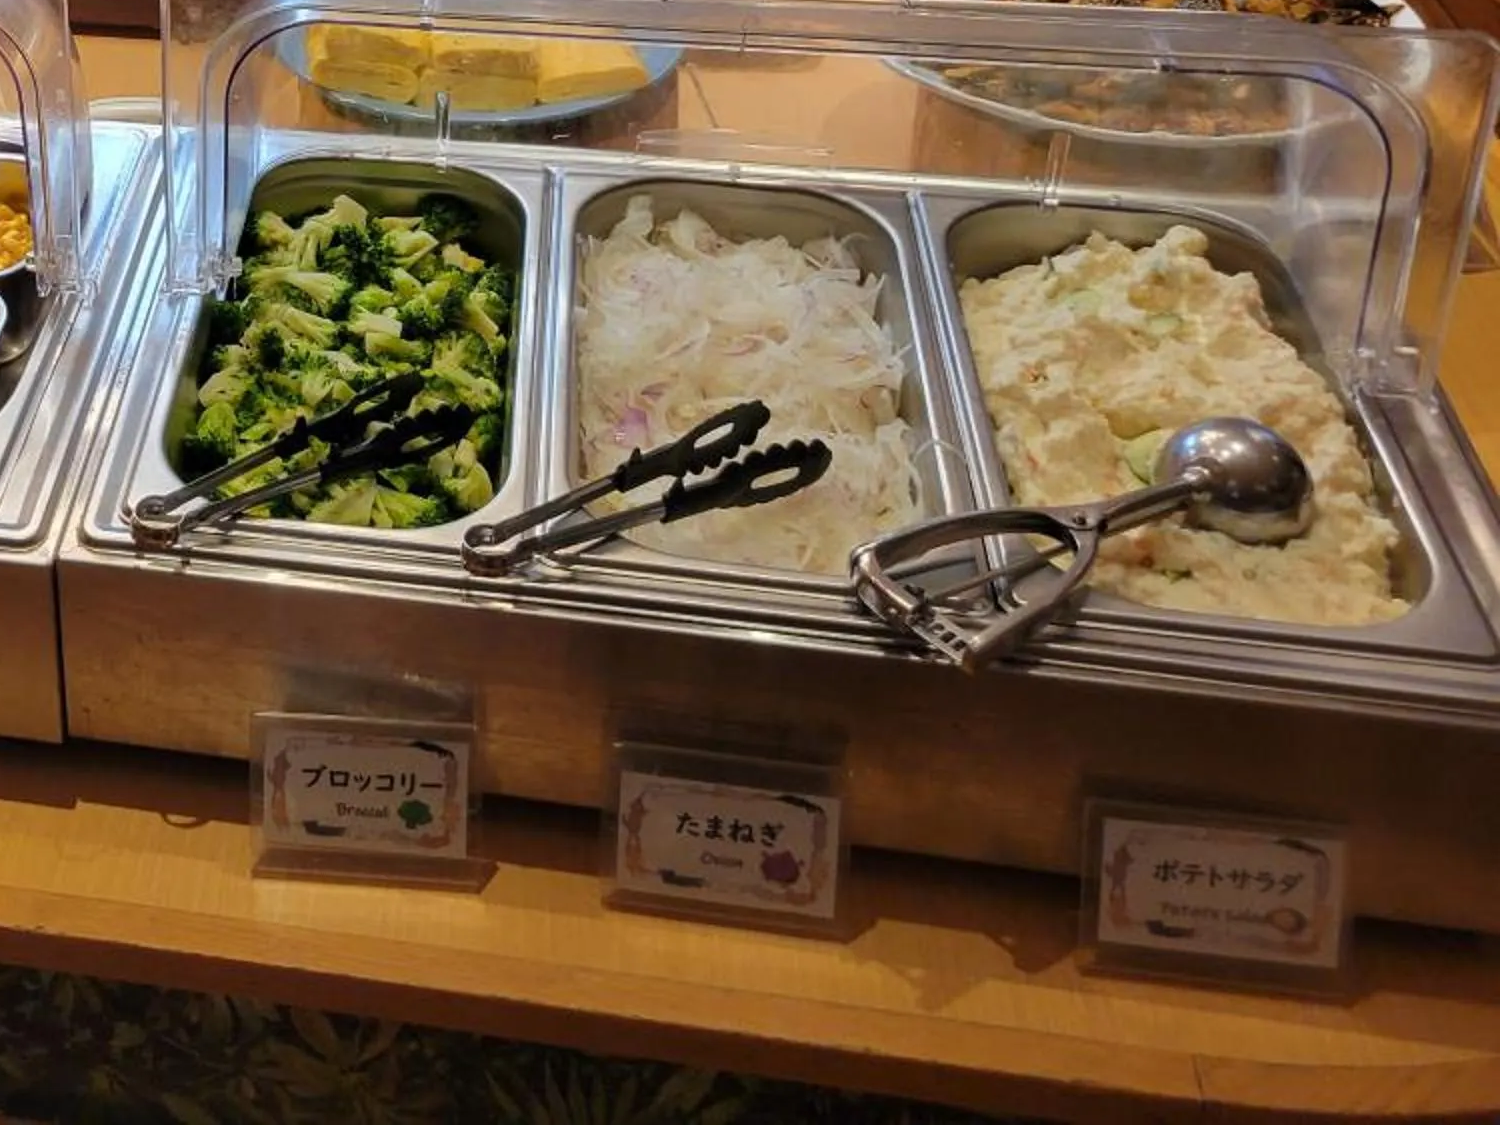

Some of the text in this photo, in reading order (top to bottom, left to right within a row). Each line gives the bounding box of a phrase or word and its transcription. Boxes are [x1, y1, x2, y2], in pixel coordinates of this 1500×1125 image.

[301, 764, 444, 796] ブロッコリー
[675, 812, 786, 847] たまねぎ
[1153, 859, 1304, 896] ポテトサラダ
